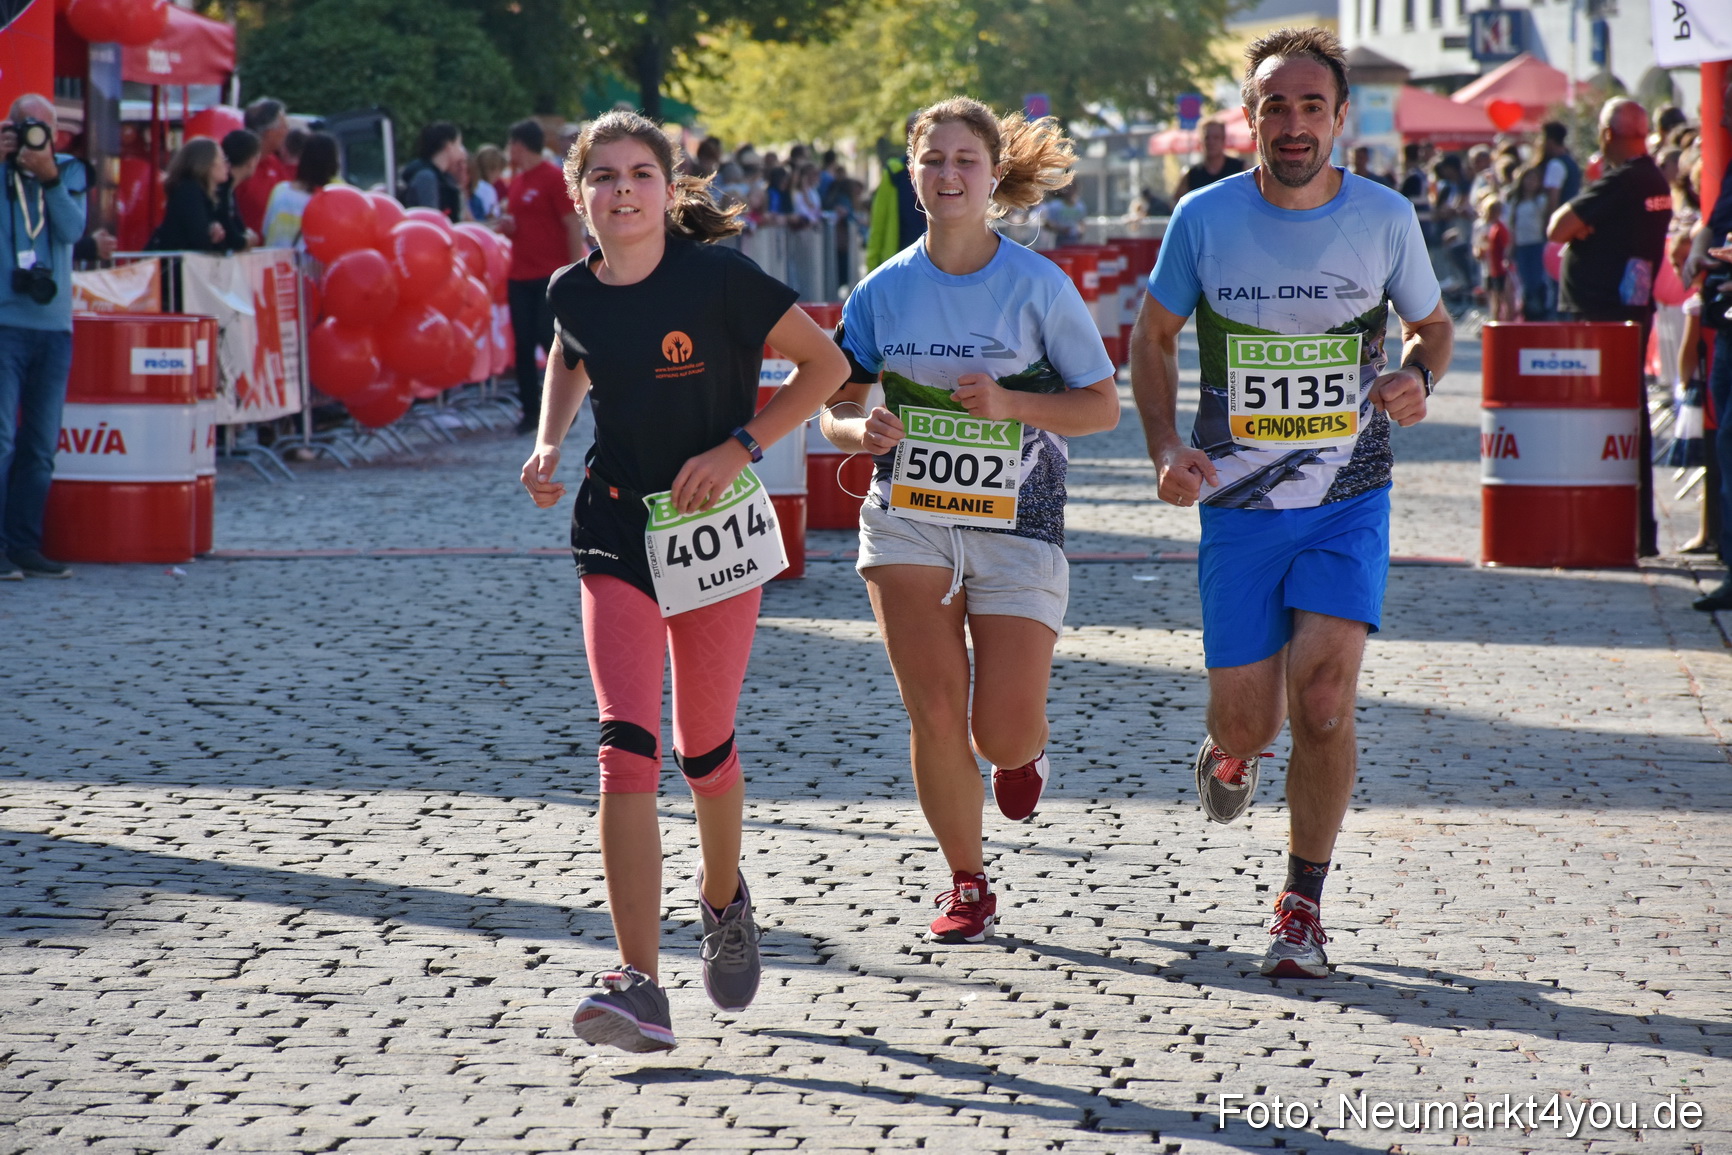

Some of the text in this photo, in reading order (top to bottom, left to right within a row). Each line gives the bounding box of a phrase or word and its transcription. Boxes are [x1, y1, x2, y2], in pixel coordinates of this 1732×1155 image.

[1218, 285, 1328, 301] RAIL.ONE
[883, 343, 975, 358] RAIL.ONE
[1238, 339, 1348, 365] BOCK
[1244, 373, 1344, 410] 5135
[909, 412, 1011, 446] BOCK
[1258, 414, 1348, 438] ANDREAS
[1481, 426, 1520, 459] VIA
[906, 446, 1004, 489] 5002
[909, 491, 994, 514] MELANIE
[666, 503, 767, 568] 4014
[698, 558, 759, 591] LUISA
